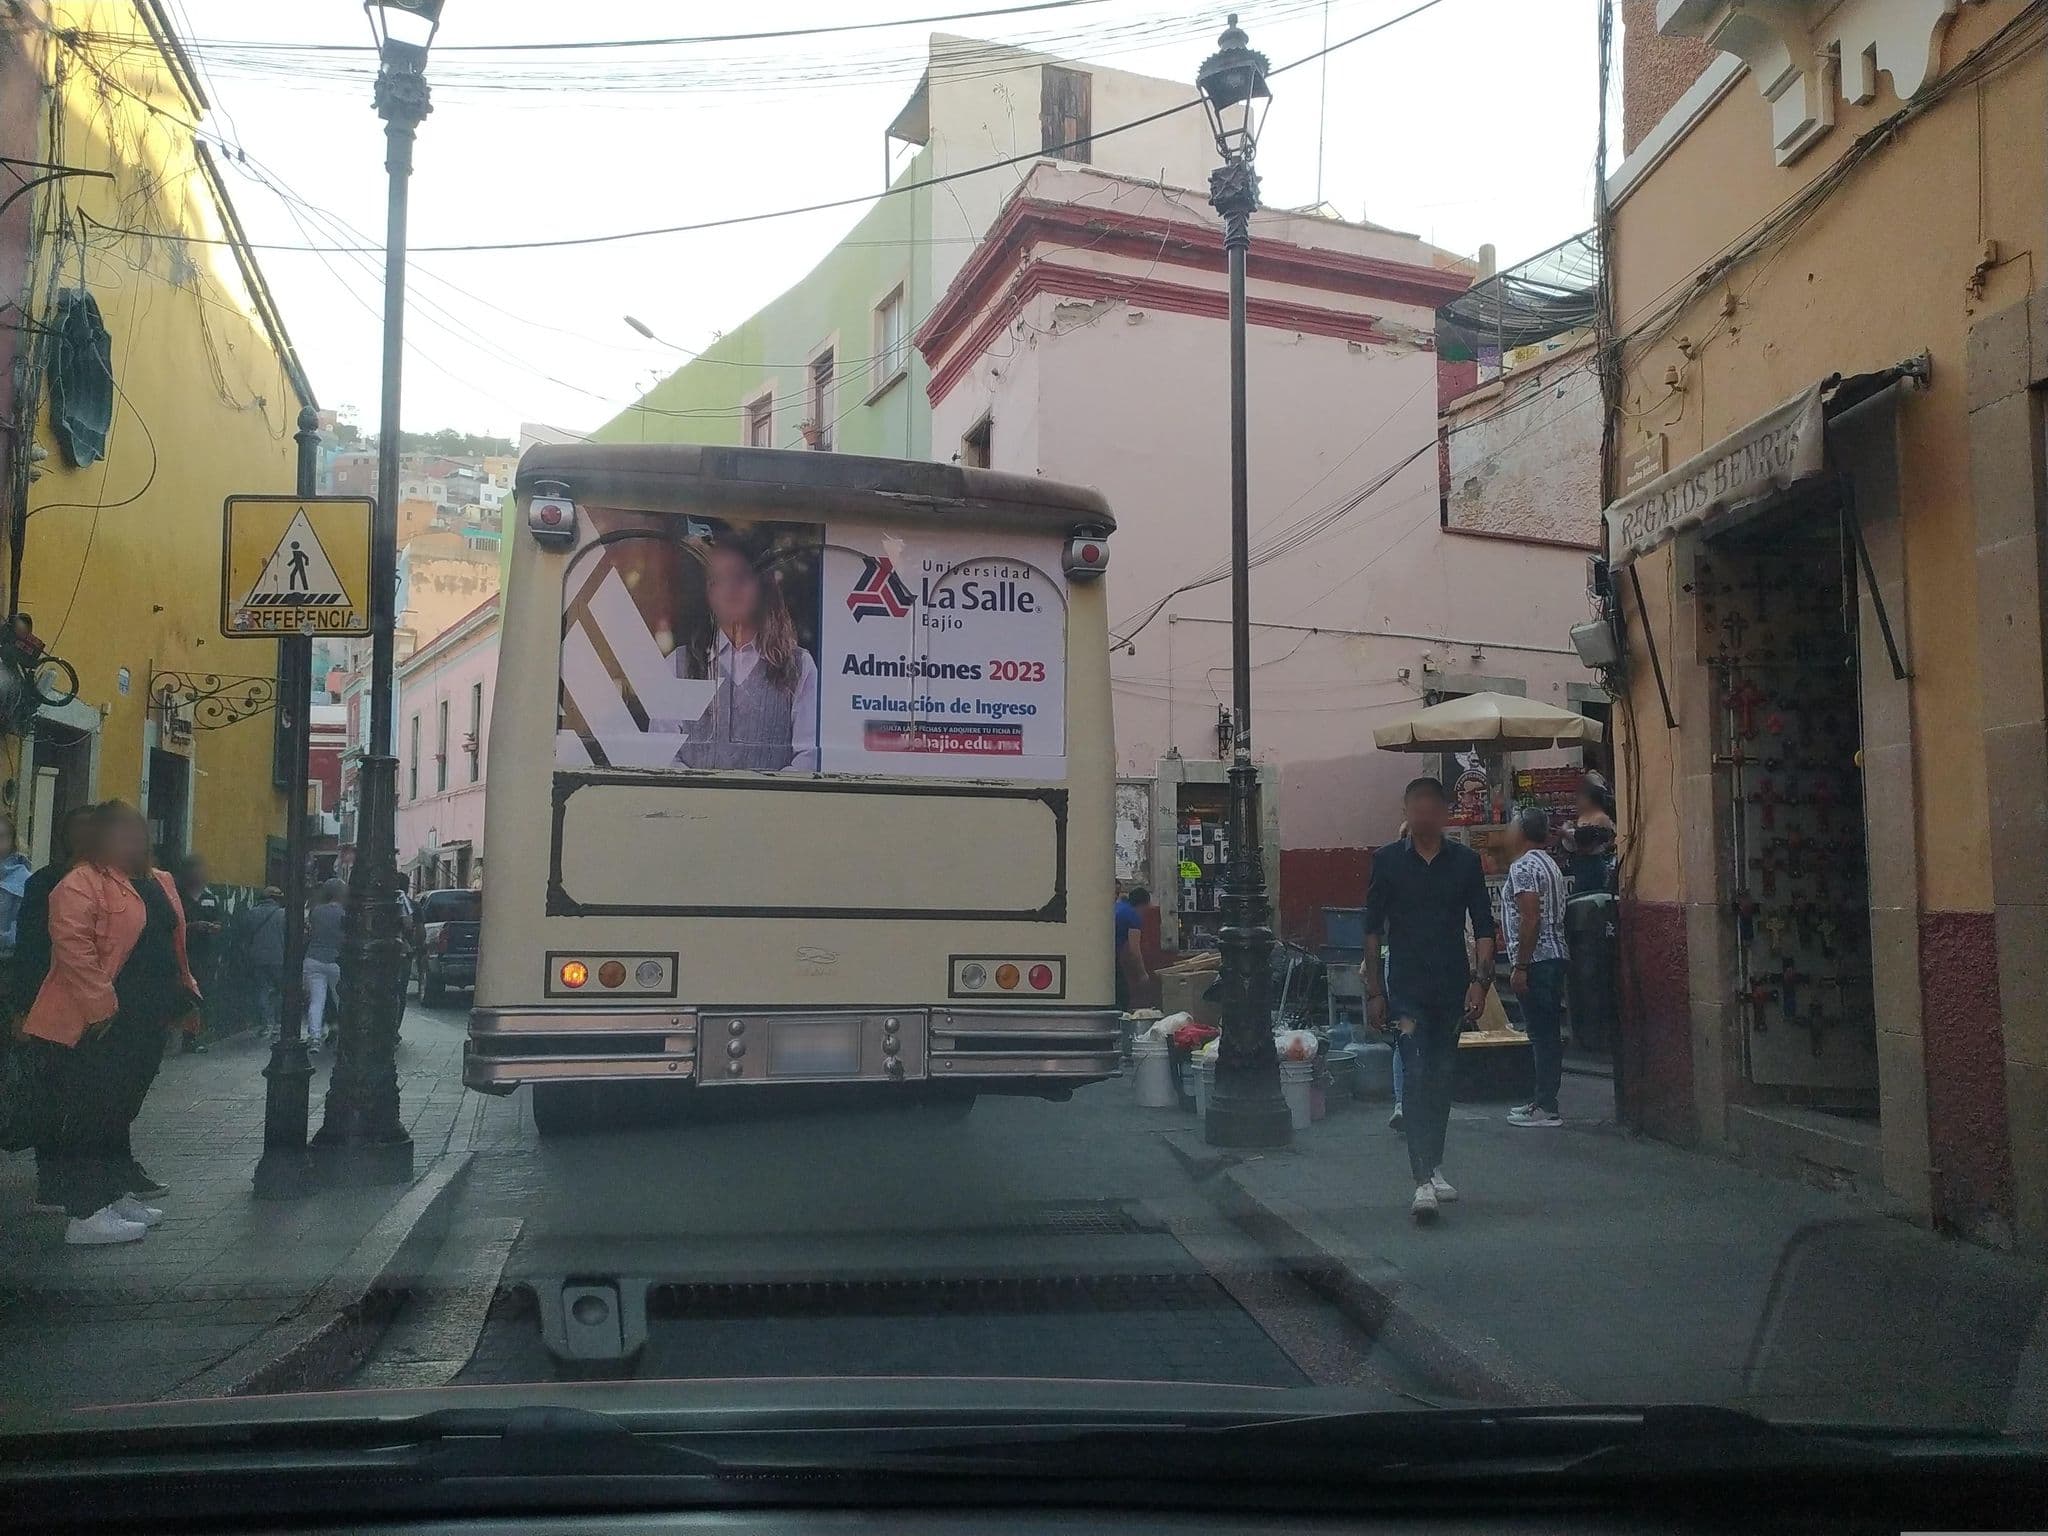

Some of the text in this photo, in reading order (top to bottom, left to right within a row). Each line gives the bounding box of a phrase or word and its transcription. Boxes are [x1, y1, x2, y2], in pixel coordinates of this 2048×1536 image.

[1622, 471, 1709, 546] REGALOS
[922, 559, 1031, 580] Universidad
[922, 613, 963, 633] Bajío
[842, 653, 1046, 683] Admisiones 2023
[851, 694, 1038, 720] Evaluación de Ingreso
[948, 727, 980, 735] ADQUIERE
